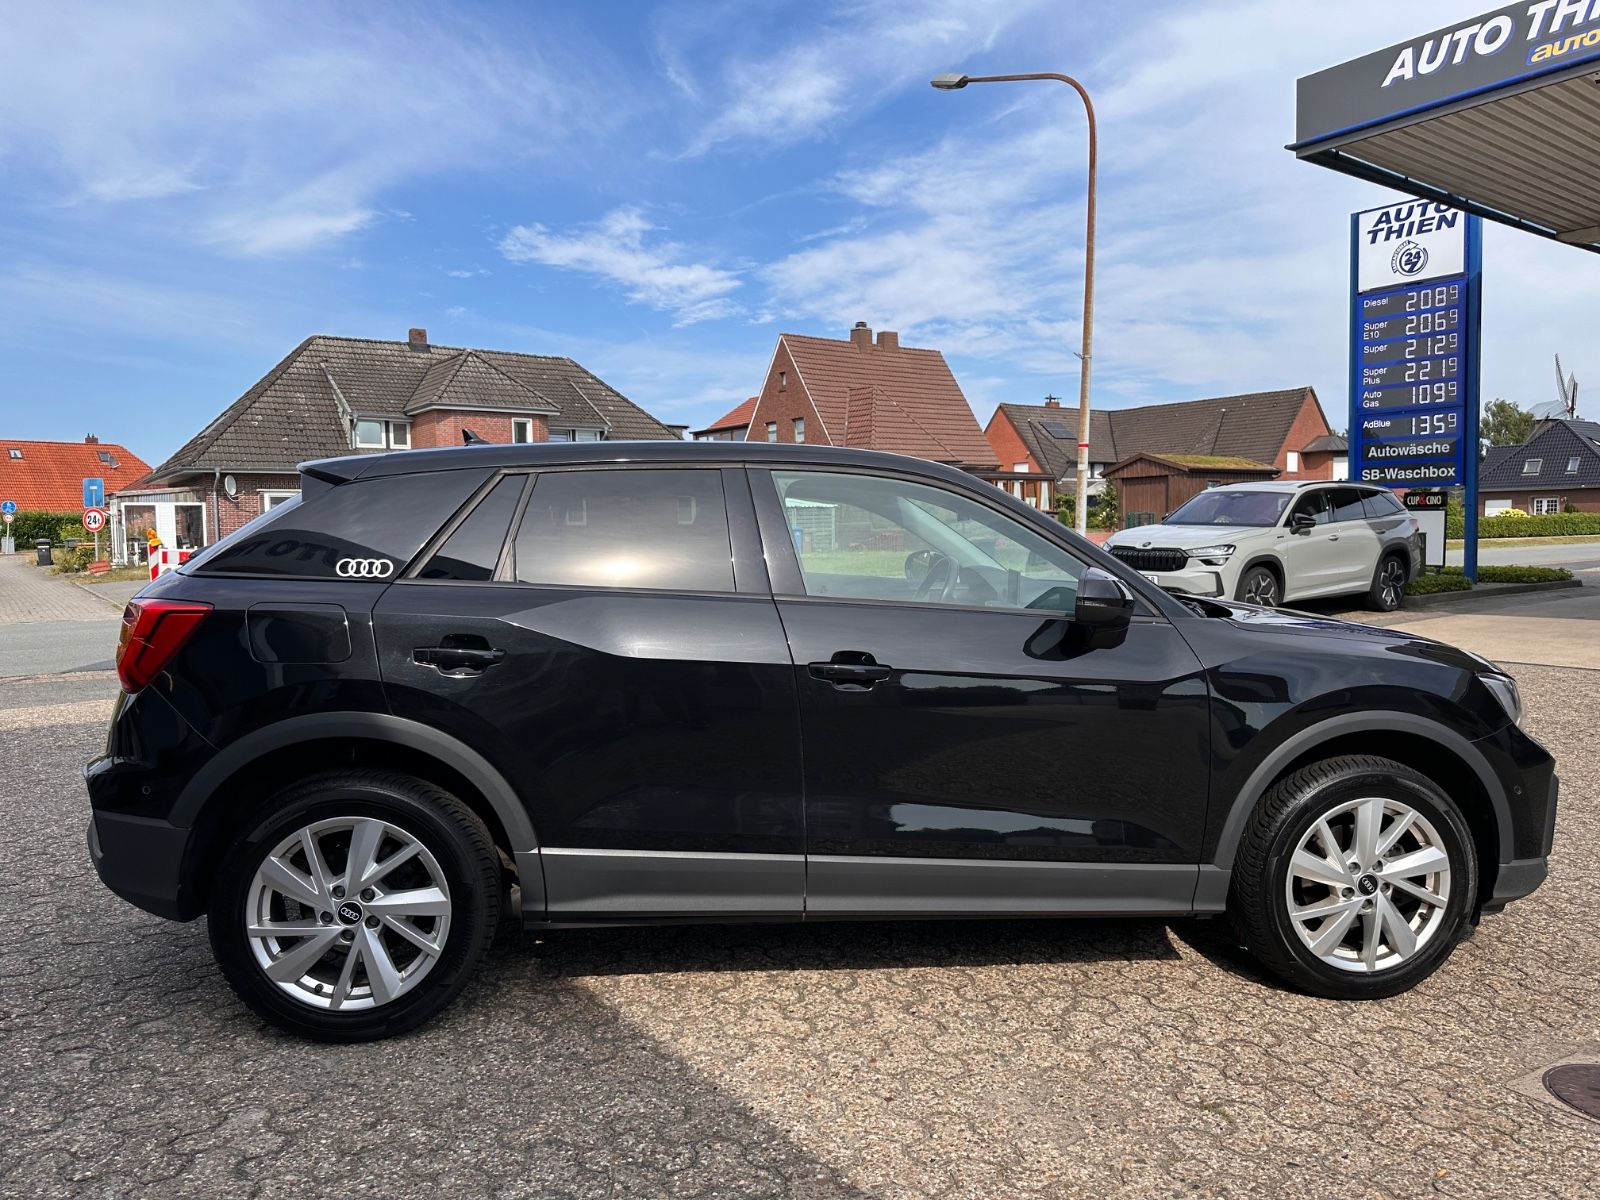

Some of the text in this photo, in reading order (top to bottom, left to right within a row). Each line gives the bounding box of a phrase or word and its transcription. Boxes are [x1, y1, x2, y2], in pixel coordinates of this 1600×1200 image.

[1381, 15, 1513, 88] AUTO
[1367, 212, 1458, 245] THIEN
[1404, 250, 1422, 263] 24
[1363, 297, 1389, 308] Diesel
[1363, 321, 1388, 331] Super
[1363, 330, 1380, 340] E10
[1363, 344, 1388, 354] Super
[1363, 367, 1388, 377] Super
[1363, 377, 1380, 386] Plus
[1363, 390, 1382, 399] Auto
[1363, 399, 1380, 408] Gas
[1363, 420, 1391, 428] AdBlue
[1367, 441, 1450, 458] Autowäsche
[1361, 465, 1456, 480] SB-Waschbox
